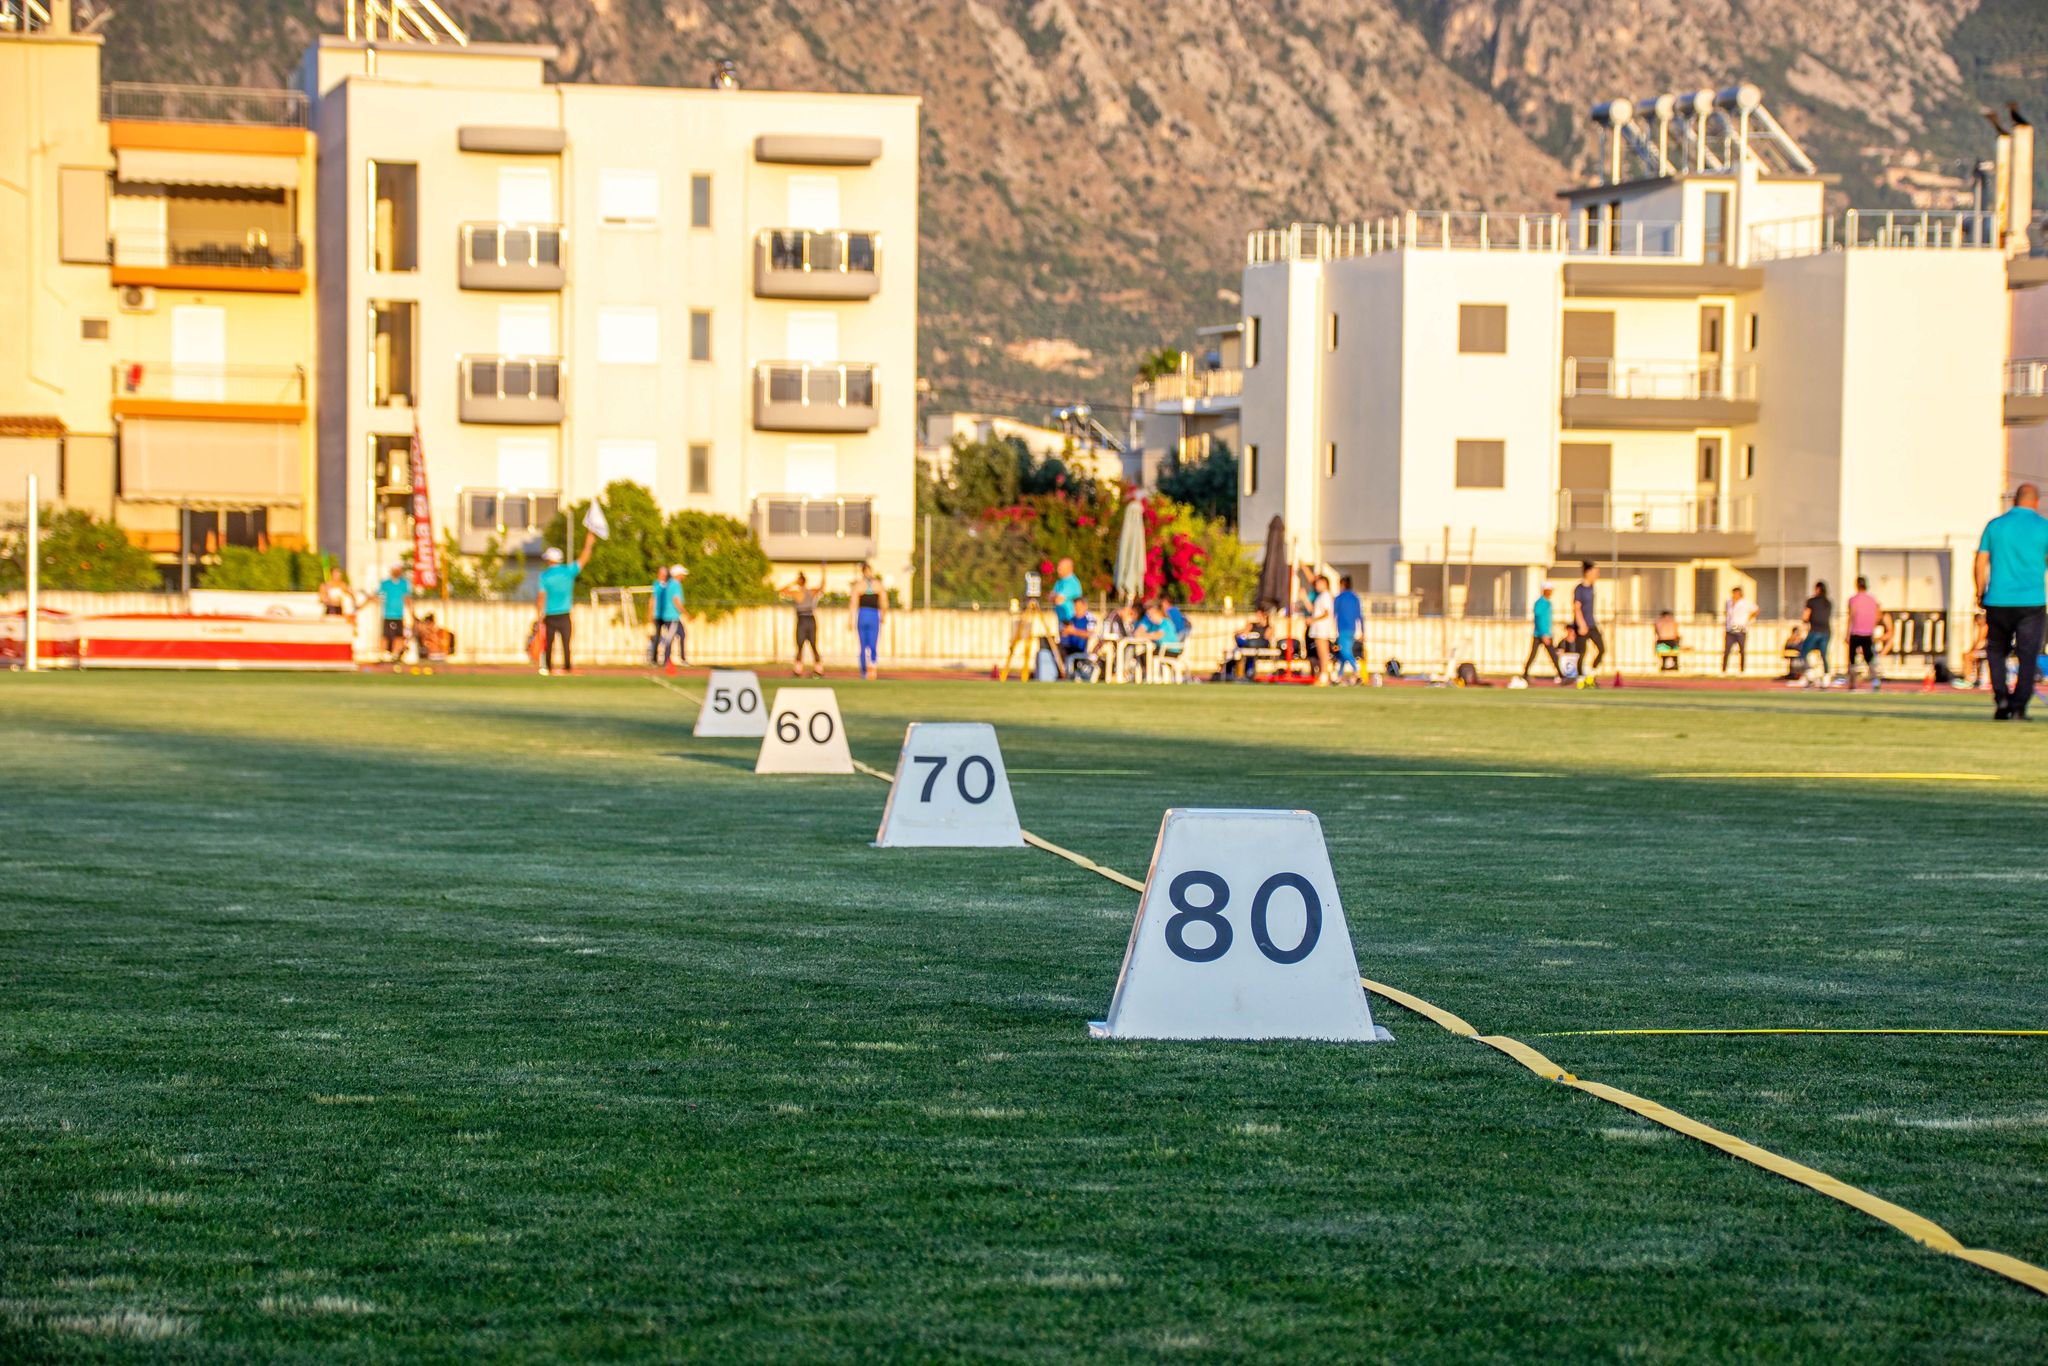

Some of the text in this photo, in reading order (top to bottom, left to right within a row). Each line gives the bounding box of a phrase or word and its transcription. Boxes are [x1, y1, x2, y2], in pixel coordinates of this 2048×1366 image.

[415, 523, 437, 585] alma
[713, 688, 758, 713] 50
[776, 711, 834, 744] 60
[913, 756, 995, 804] 70
[1165, 870, 1322, 964] 80
